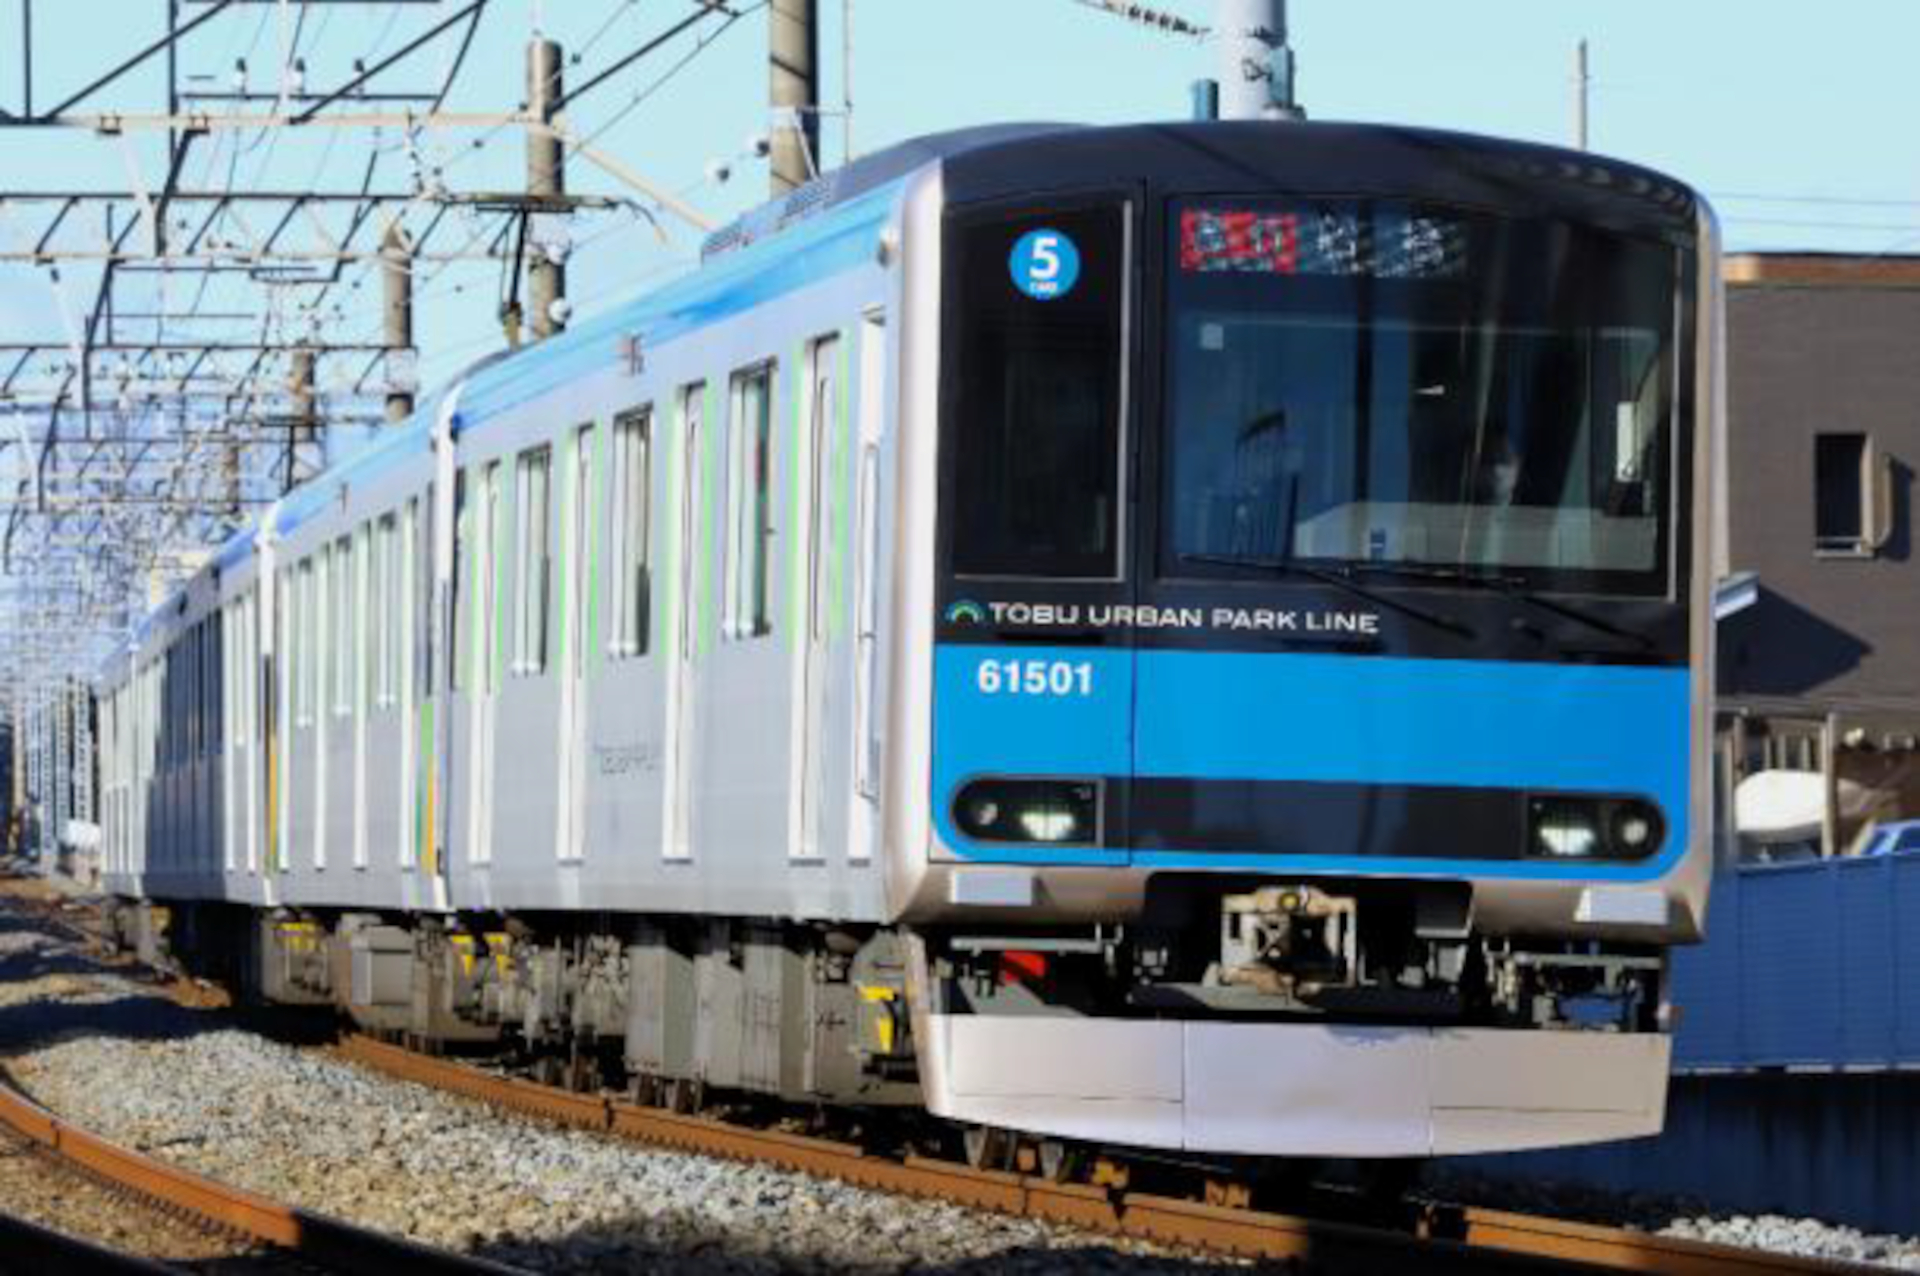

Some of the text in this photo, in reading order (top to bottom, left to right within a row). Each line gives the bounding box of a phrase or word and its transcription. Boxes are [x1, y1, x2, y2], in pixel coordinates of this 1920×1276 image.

[1029, 237, 1060, 280] 5
[988, 602, 1380, 634] TOBU URBAN PARK LINE
[978, 658, 1092, 696] 61501
